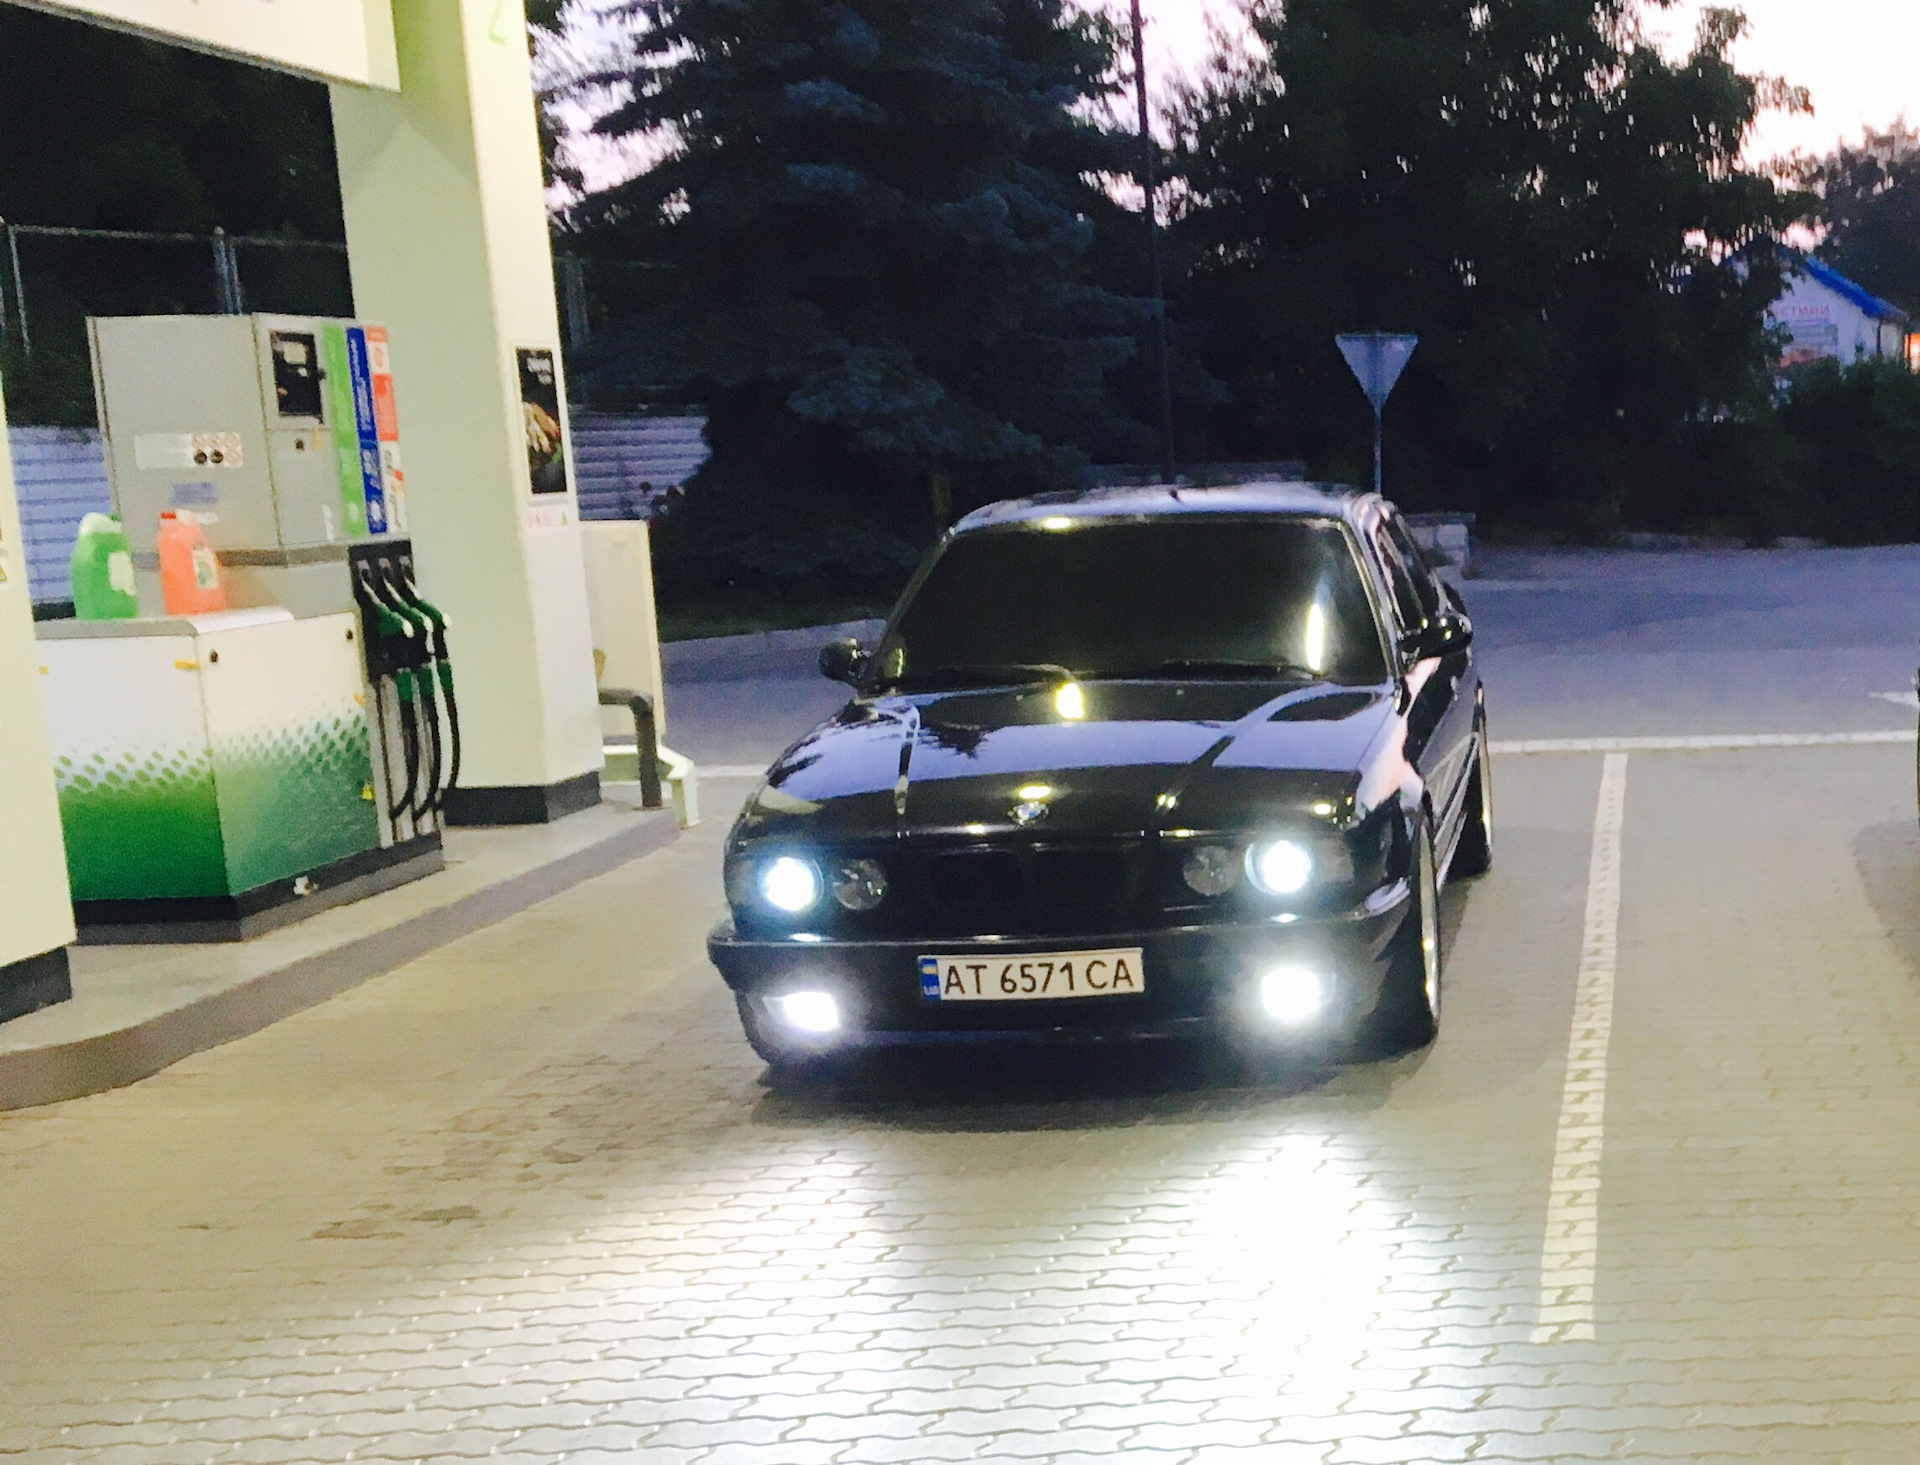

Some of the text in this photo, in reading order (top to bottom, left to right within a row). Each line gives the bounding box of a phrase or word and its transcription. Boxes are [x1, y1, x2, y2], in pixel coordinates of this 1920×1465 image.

[944, 957, 1135, 995] AT 6571 CA
